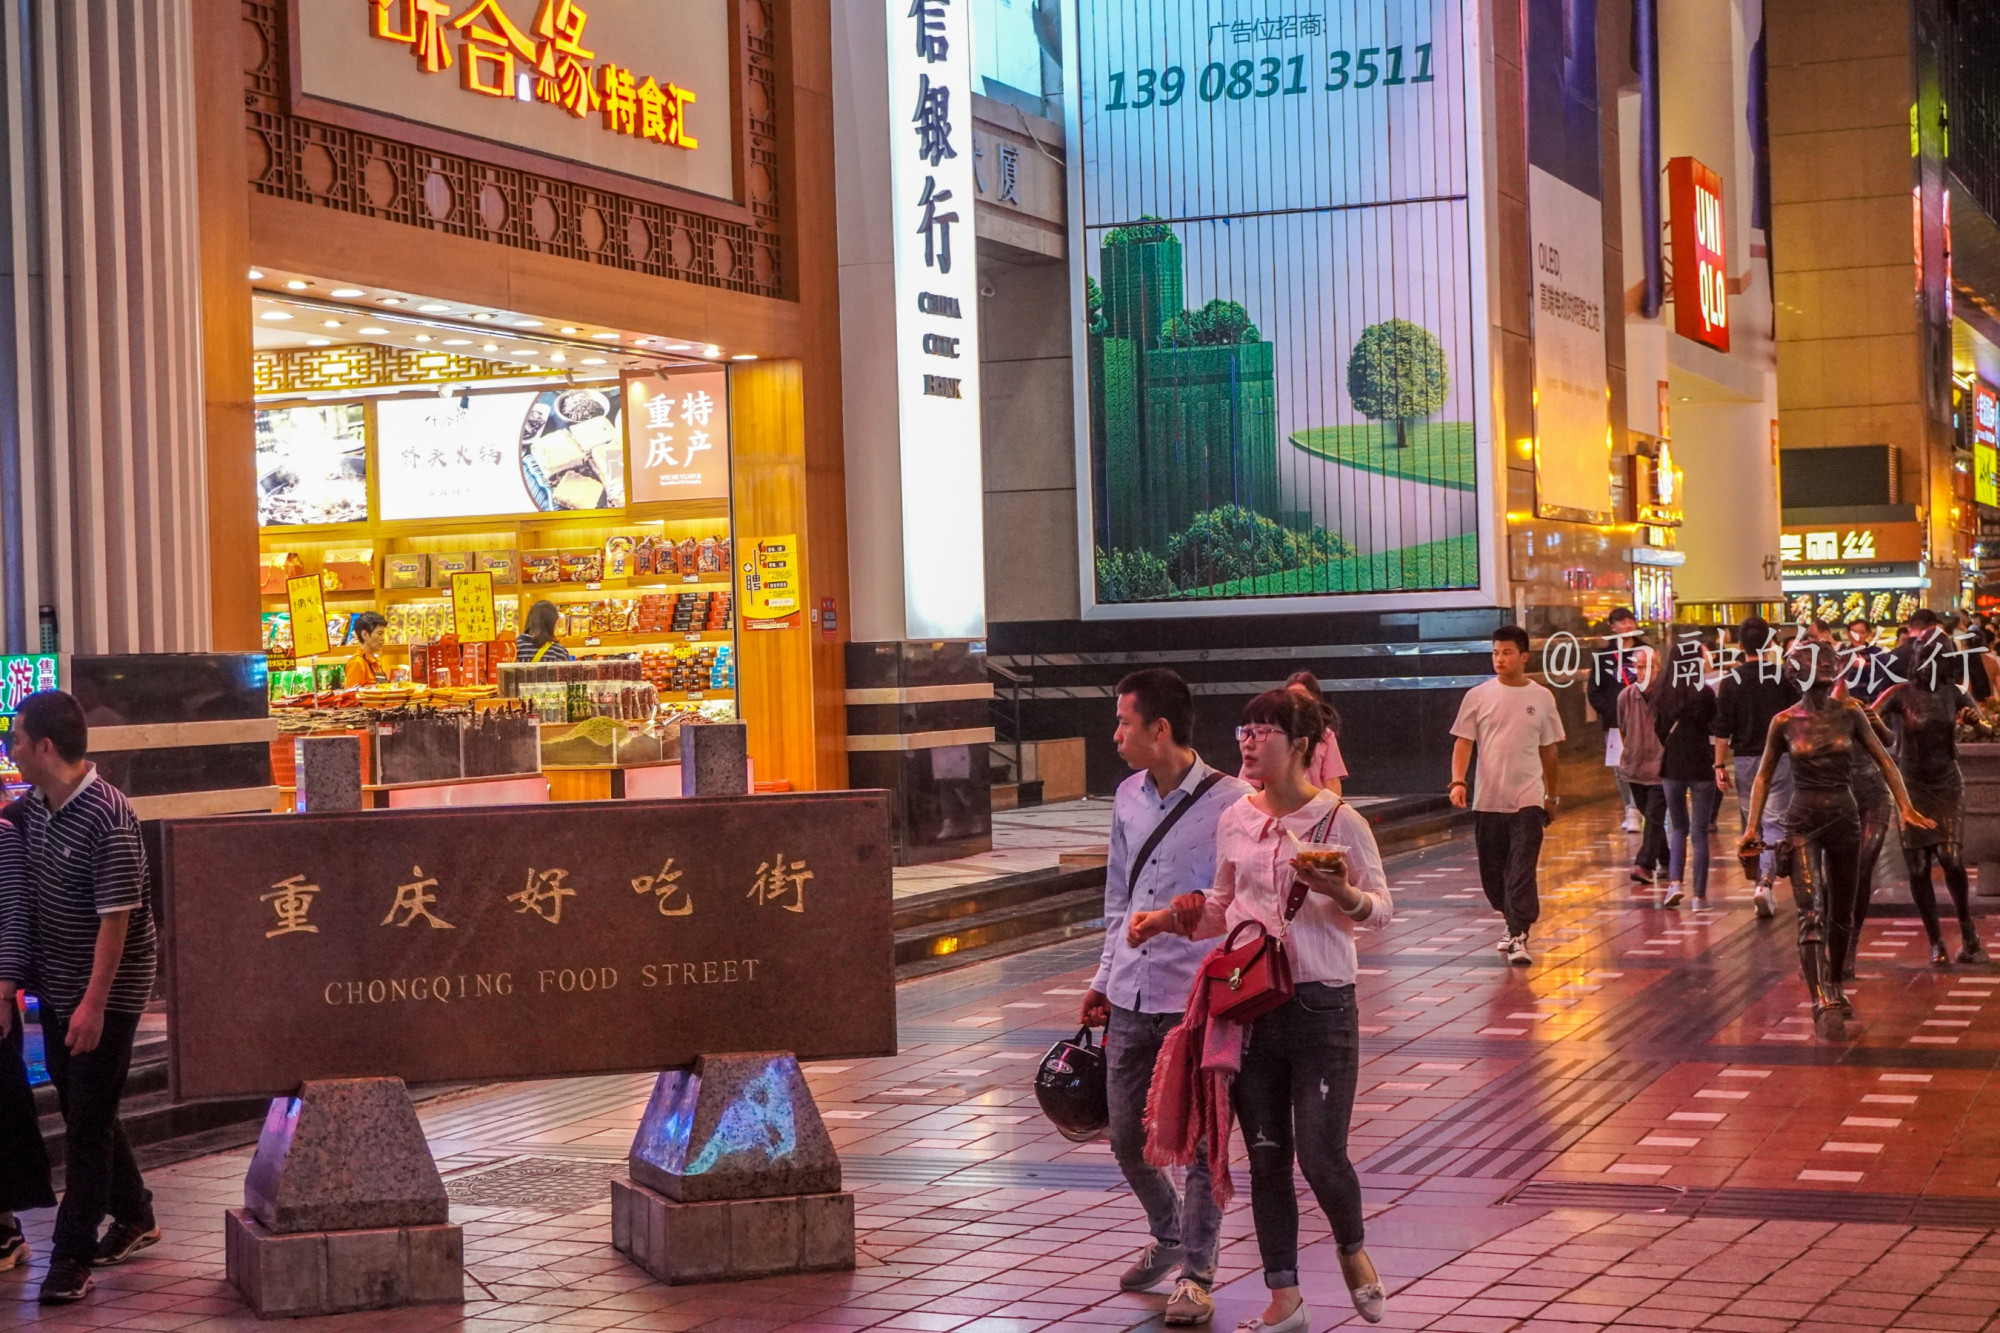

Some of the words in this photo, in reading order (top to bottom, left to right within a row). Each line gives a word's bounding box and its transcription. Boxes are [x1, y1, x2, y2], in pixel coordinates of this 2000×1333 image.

[1105, 65, 1185, 112] 139
[1199, 54, 1308, 103] 0831
[1324, 42, 1435, 92] 3511
[1695, 184, 1722, 256] UNI
[1699, 260, 1726, 332] QLO
[923, 374, 962, 400] BANK
[260, 853, 815, 939] 重庆好吃街
[325, 973, 514, 1006] CHONGQING
[538, 966, 618, 994] FOOD
[643, 958, 760, 989] STREET
